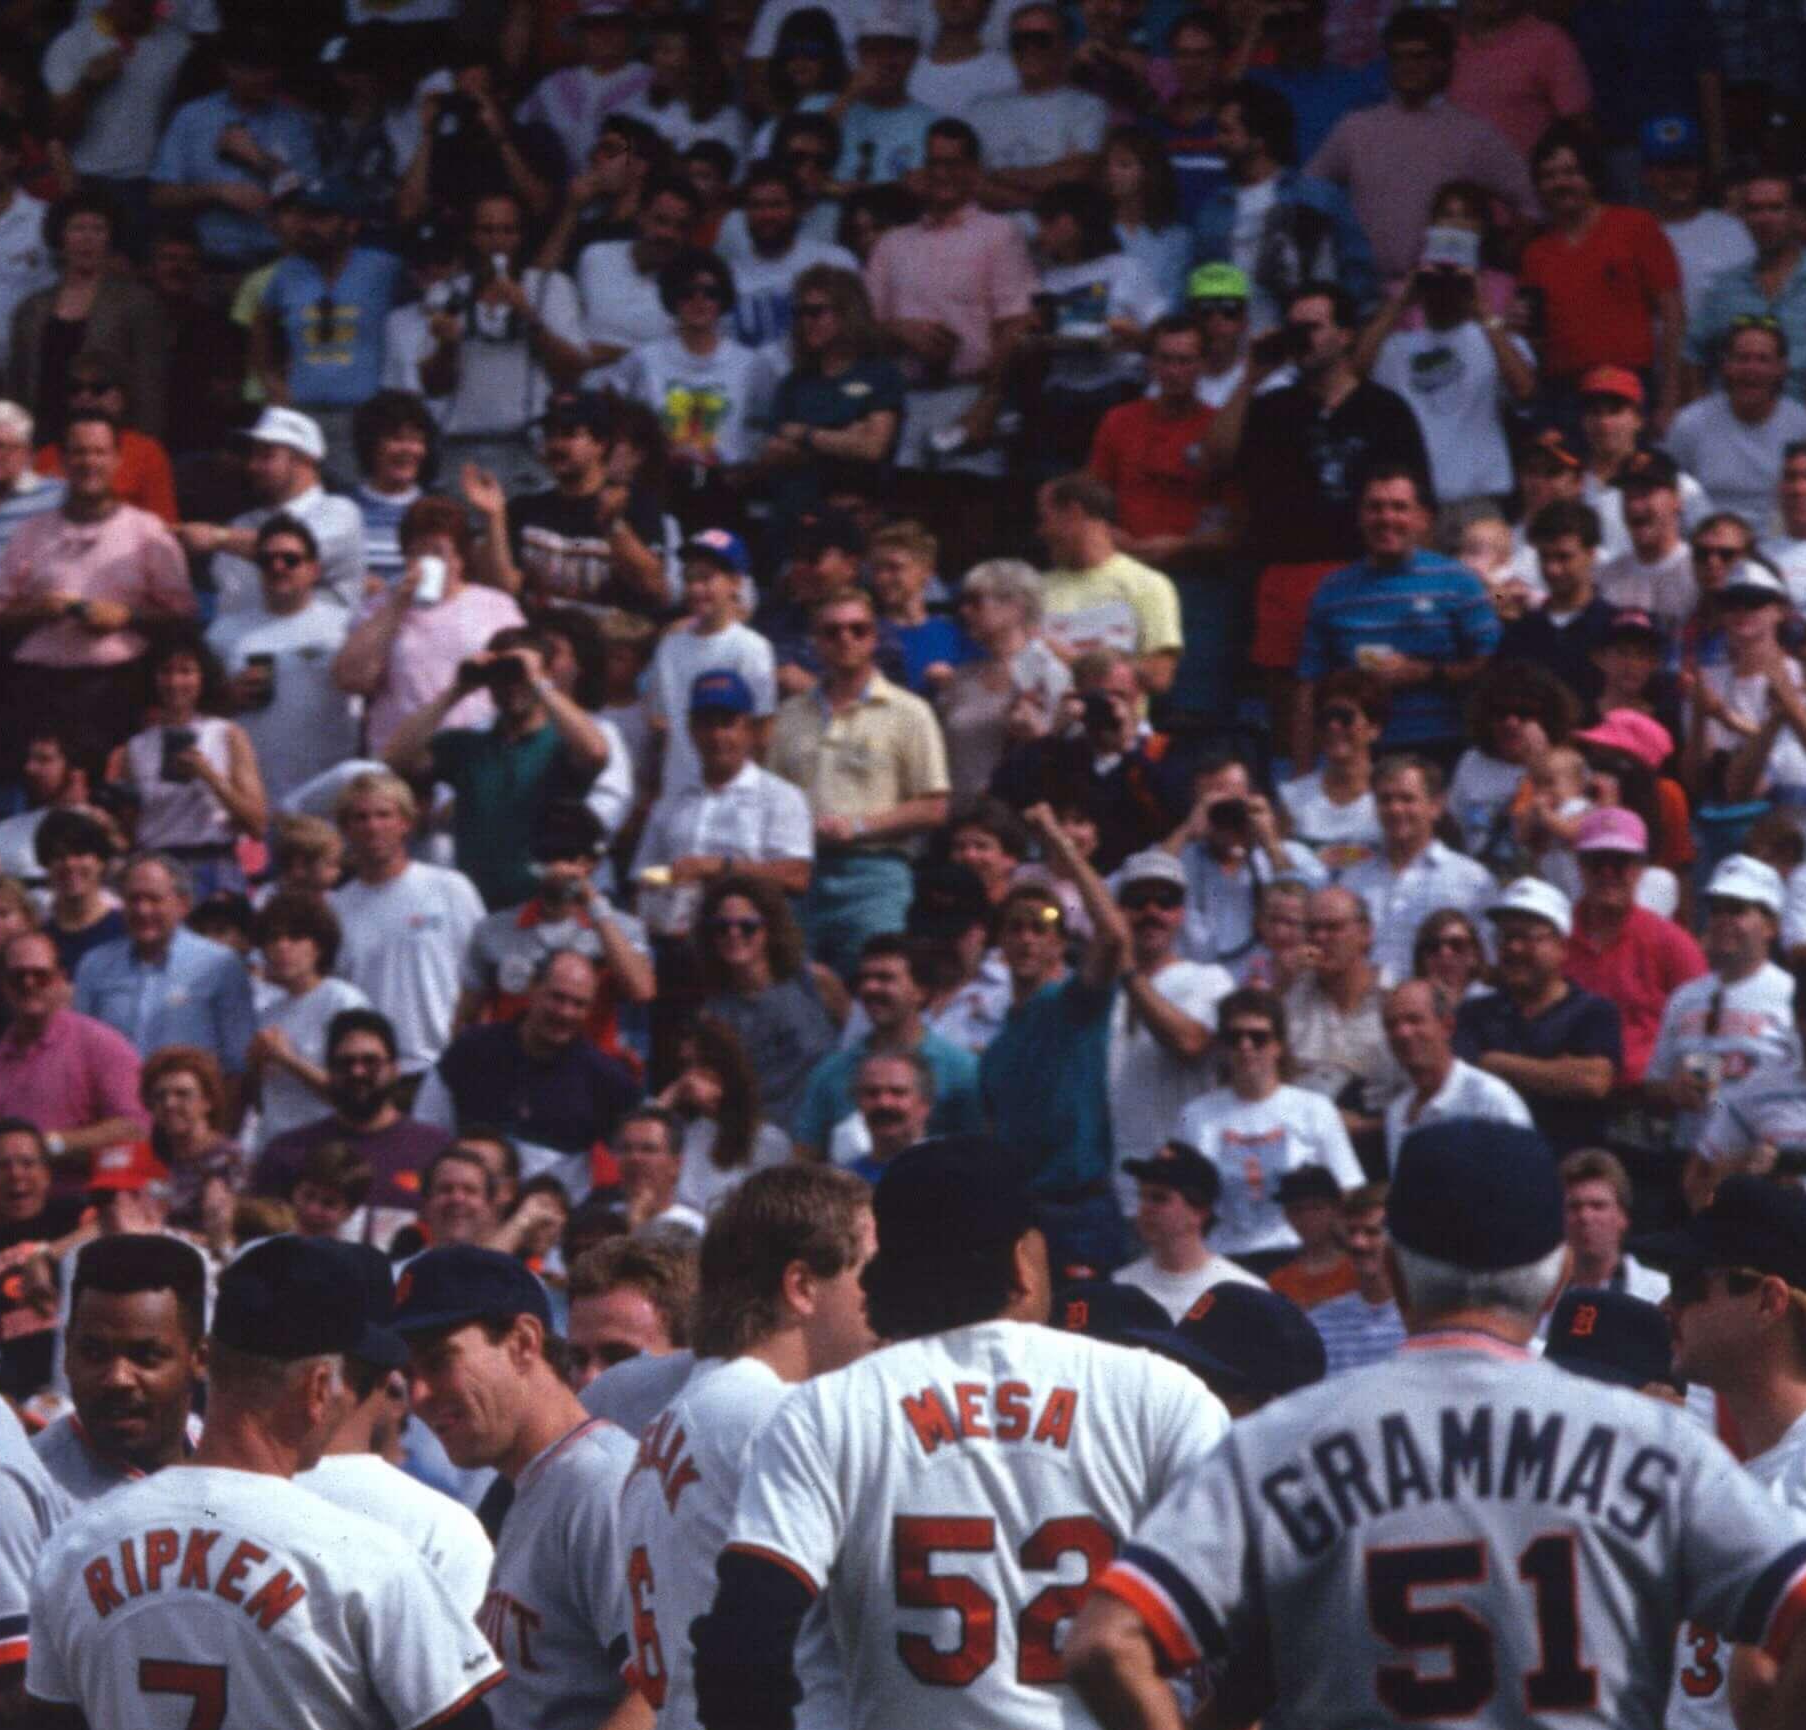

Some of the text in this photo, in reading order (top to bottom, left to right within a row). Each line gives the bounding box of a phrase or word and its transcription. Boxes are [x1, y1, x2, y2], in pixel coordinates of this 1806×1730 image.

[900, 1380, 1079, 1454] MESA
[1260, 1406, 1680, 1558] GRAMMAS
[83, 1528, 307, 1630] RIPKEN
[892, 1515, 1119, 1689] 52
[1364, 1530, 1600, 1723] 51
